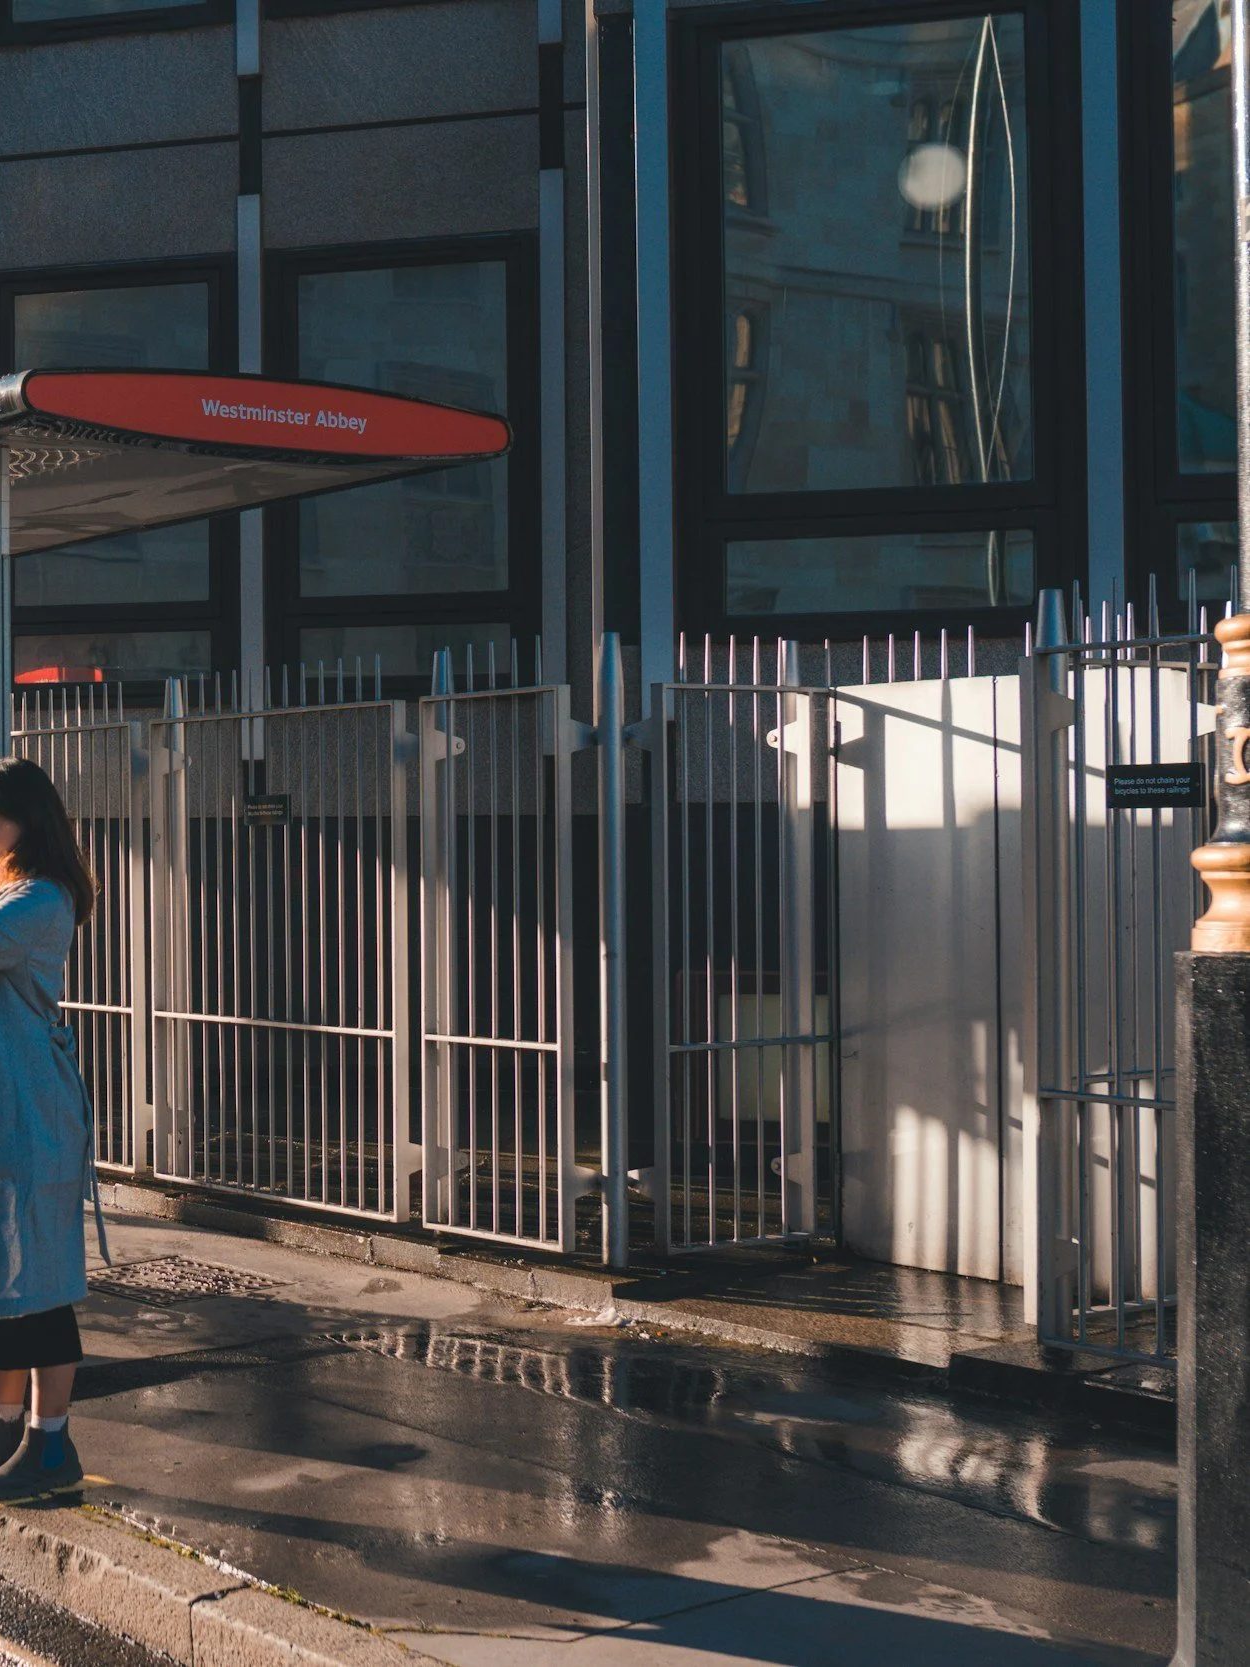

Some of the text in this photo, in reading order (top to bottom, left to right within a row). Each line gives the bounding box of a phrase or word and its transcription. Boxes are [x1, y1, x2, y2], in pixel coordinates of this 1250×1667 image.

[201, 398, 368, 435] Westminster Abbey
[1113, 777, 1136, 786] Please
[1145, 777, 1156, 785] not
[1175, 777, 1191, 787] your
[1114, 786, 1191, 797] bicycles to these railings
